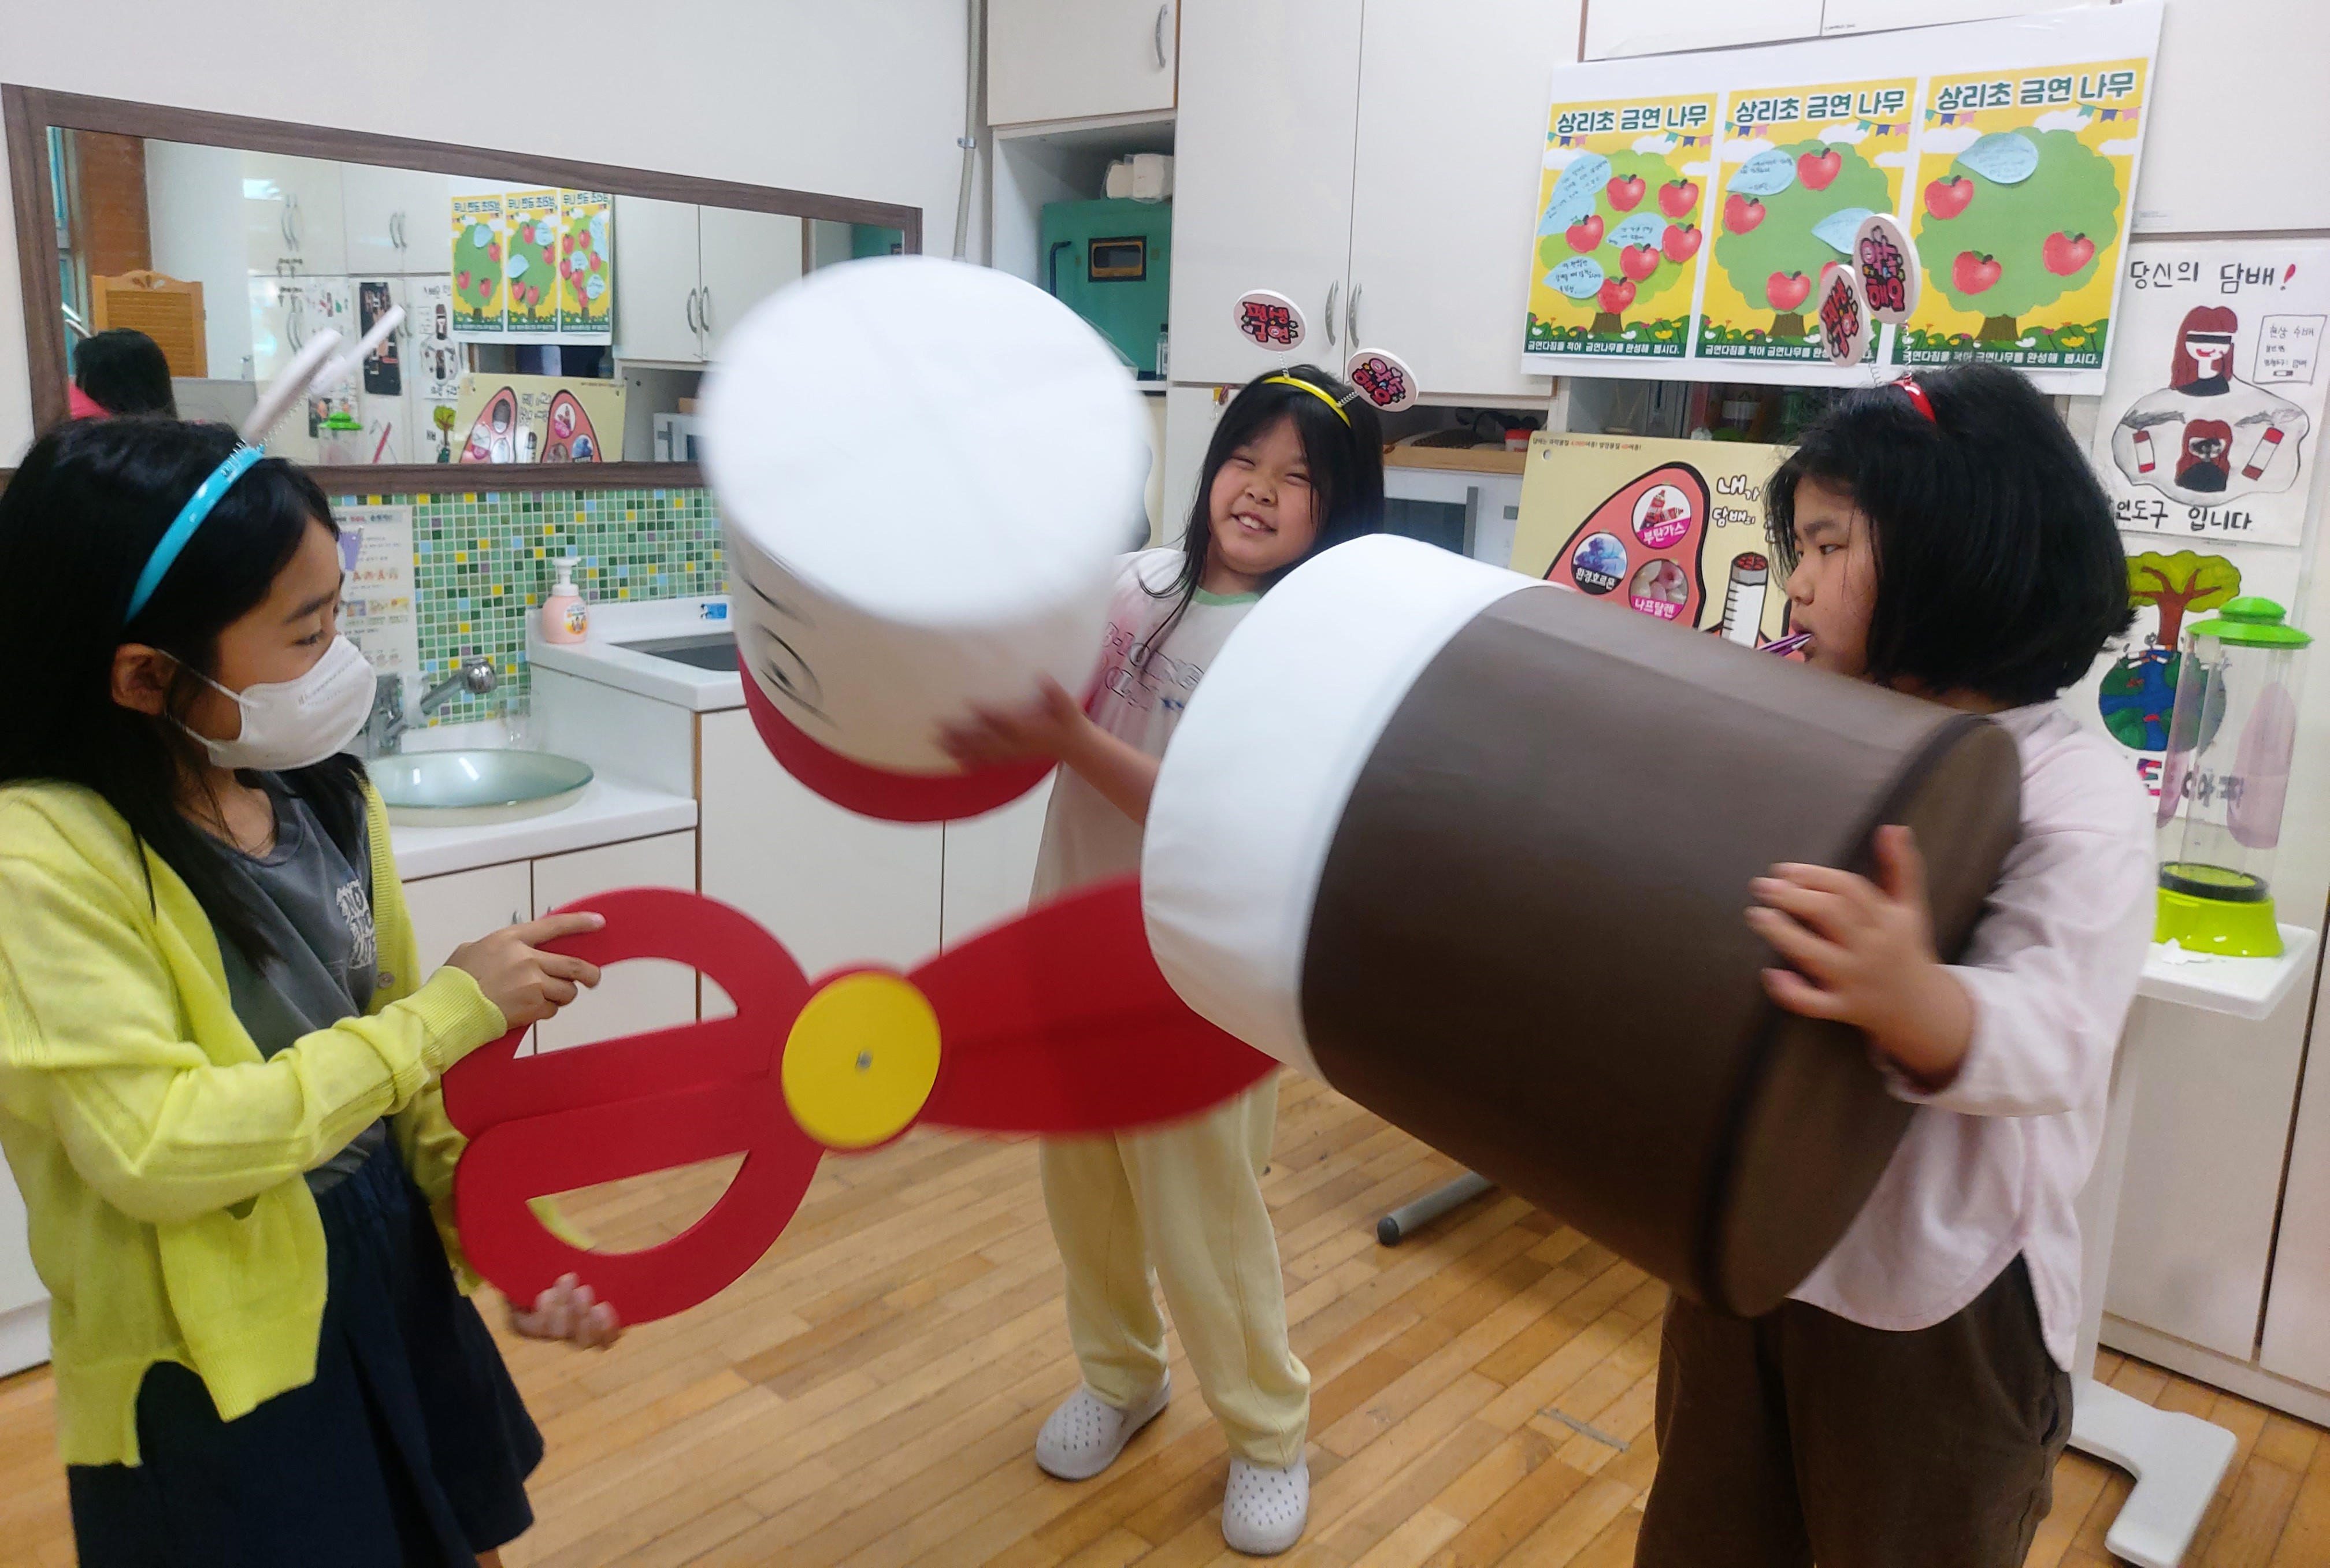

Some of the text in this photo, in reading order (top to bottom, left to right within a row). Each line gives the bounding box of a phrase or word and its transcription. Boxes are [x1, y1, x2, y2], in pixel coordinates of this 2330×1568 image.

[1938, 72, 2134, 110] 상리초 금연 나무
[1557, 105, 1706, 134] 상리초 금연 나무
[1736, 90, 1904, 122] 상리초 금연 나무
[2130, 261, 2296, 295] 당신의 담배!
[1567, 342, 1582, 352] 적어
[2027, 352, 2058, 365] 완성해
[1716, 474, 1760, 501] 내가
[2116, 499, 2253, 532] 인도구 입니다
[1643, 522, 1686, 545] 부탄가스
[1576, 567, 1615, 590] 환경호르몬
[1635, 598, 1674, 619] 나프탈렌
